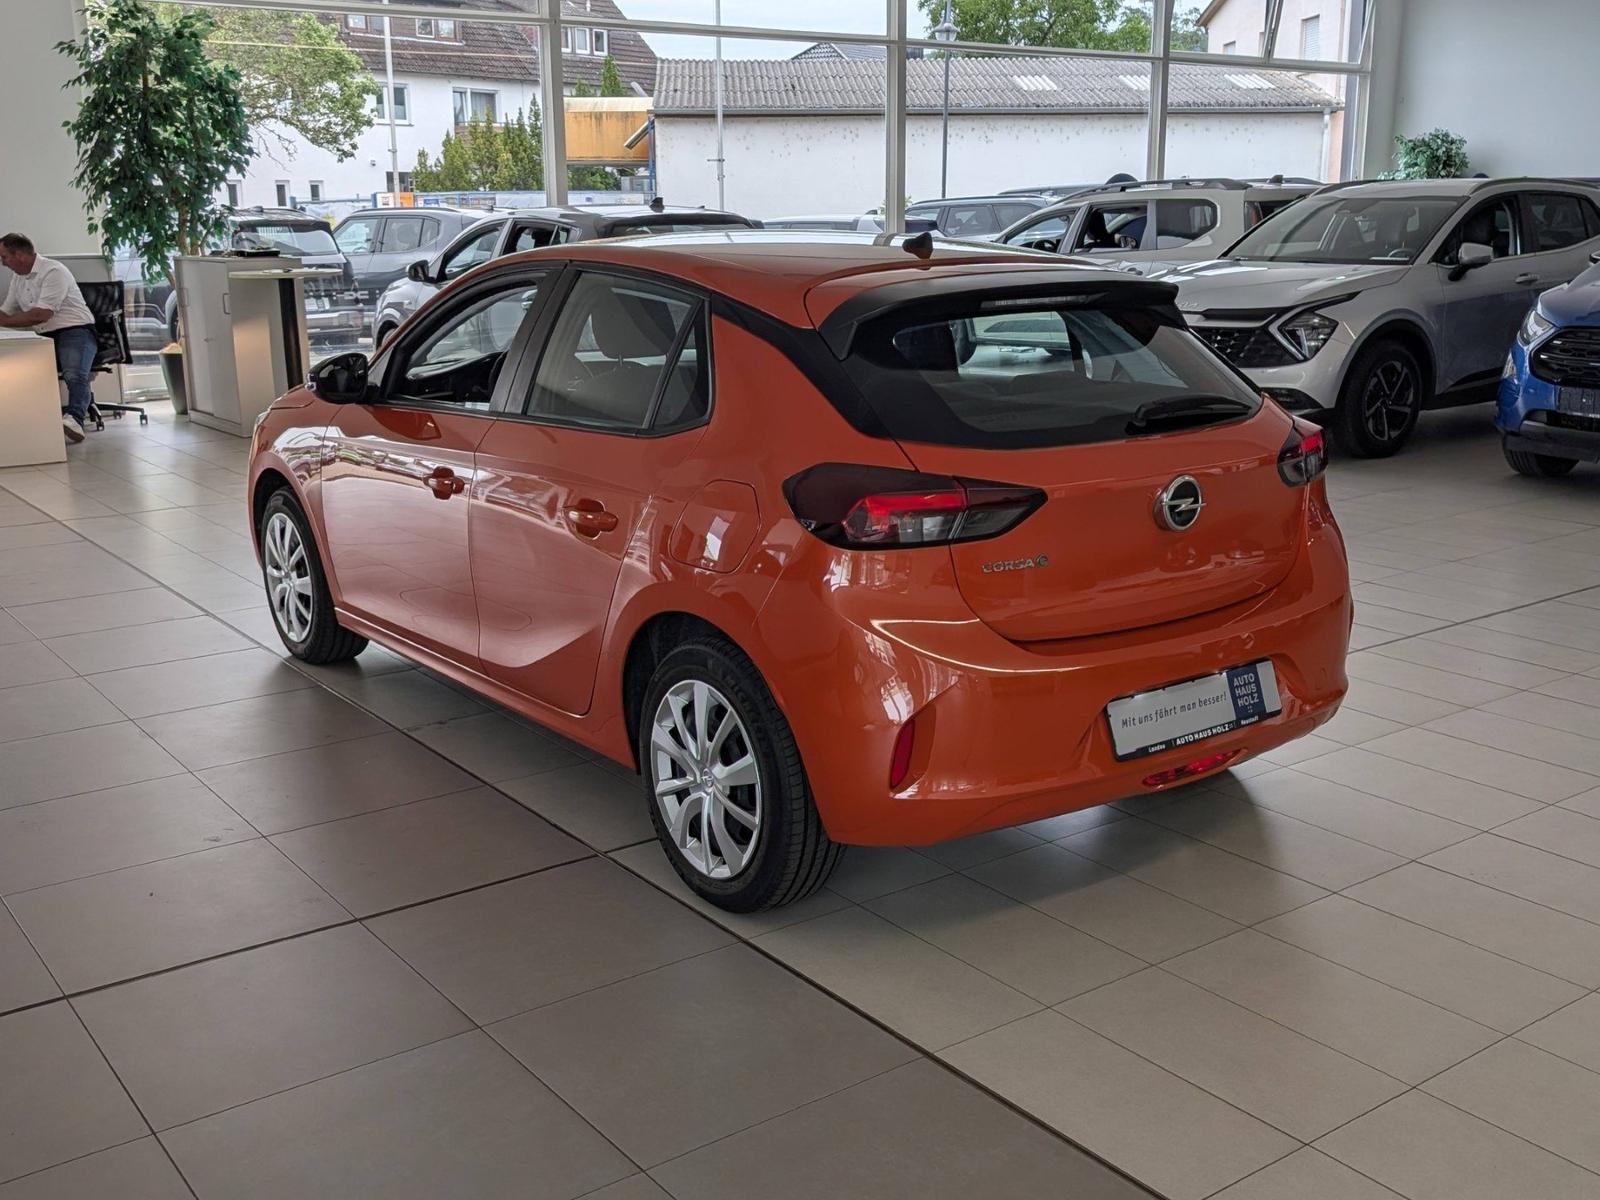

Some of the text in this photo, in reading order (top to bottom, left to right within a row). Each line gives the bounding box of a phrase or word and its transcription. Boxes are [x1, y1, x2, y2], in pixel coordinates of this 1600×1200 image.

[982, 559, 1035, 573] CORSA
[1233, 673, 1255, 687] AUTO
[1235, 683, 1257, 697] HAUS
[1237, 693, 1260, 707] HOLZ
[1121, 691, 1227, 729] Mit uns fährt man besser!
[1176, 735, 1194, 746] AUTO
[1194, 730, 1212, 741] HAUS
[1212, 723, 1230, 736] HOLZ
